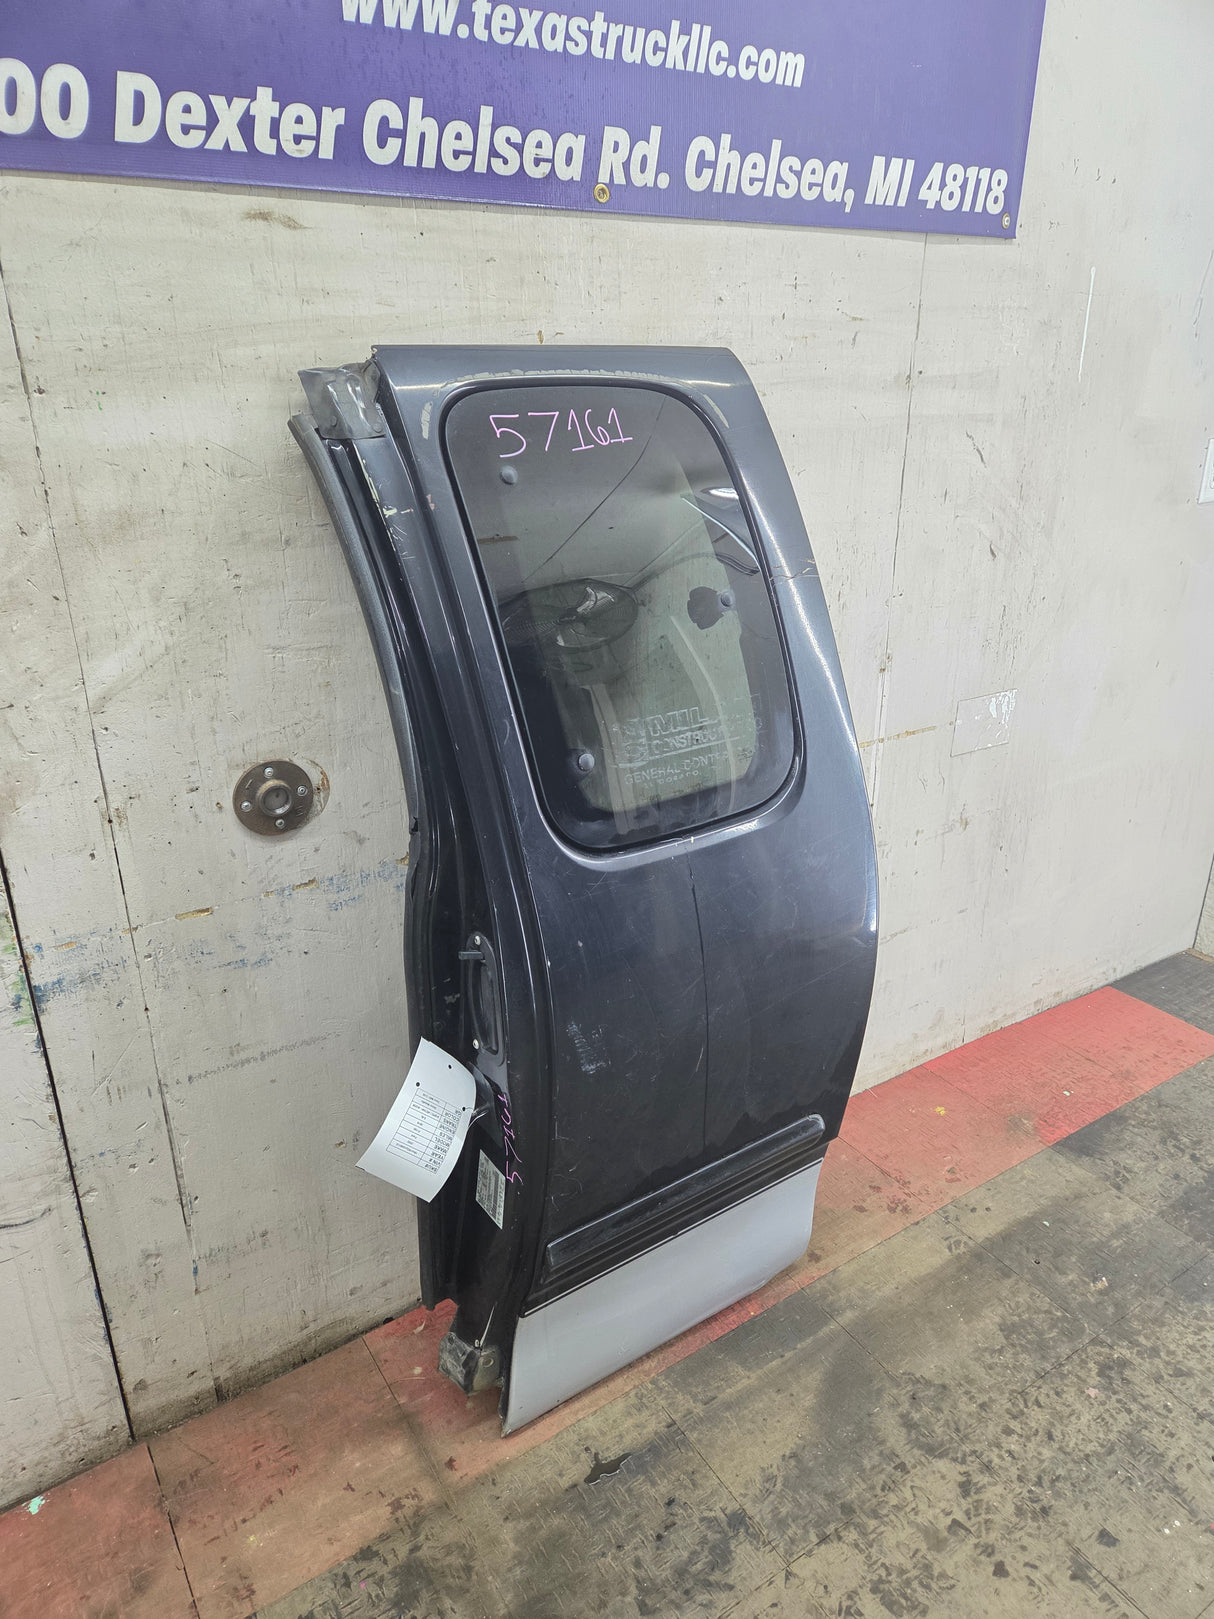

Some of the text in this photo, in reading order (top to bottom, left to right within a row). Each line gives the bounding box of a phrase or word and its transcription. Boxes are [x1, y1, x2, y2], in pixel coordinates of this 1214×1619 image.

[114, 70, 345, 160] Dexter
[362, 97, 586, 181] Chelsea
[598, 126, 670, 189] Rd.
[685, 133, 855, 213] Chelsea,
[864, 155, 915, 207] MI
[918, 162, 1008, 215] 48118
[489, 408, 633, 458] 57161
